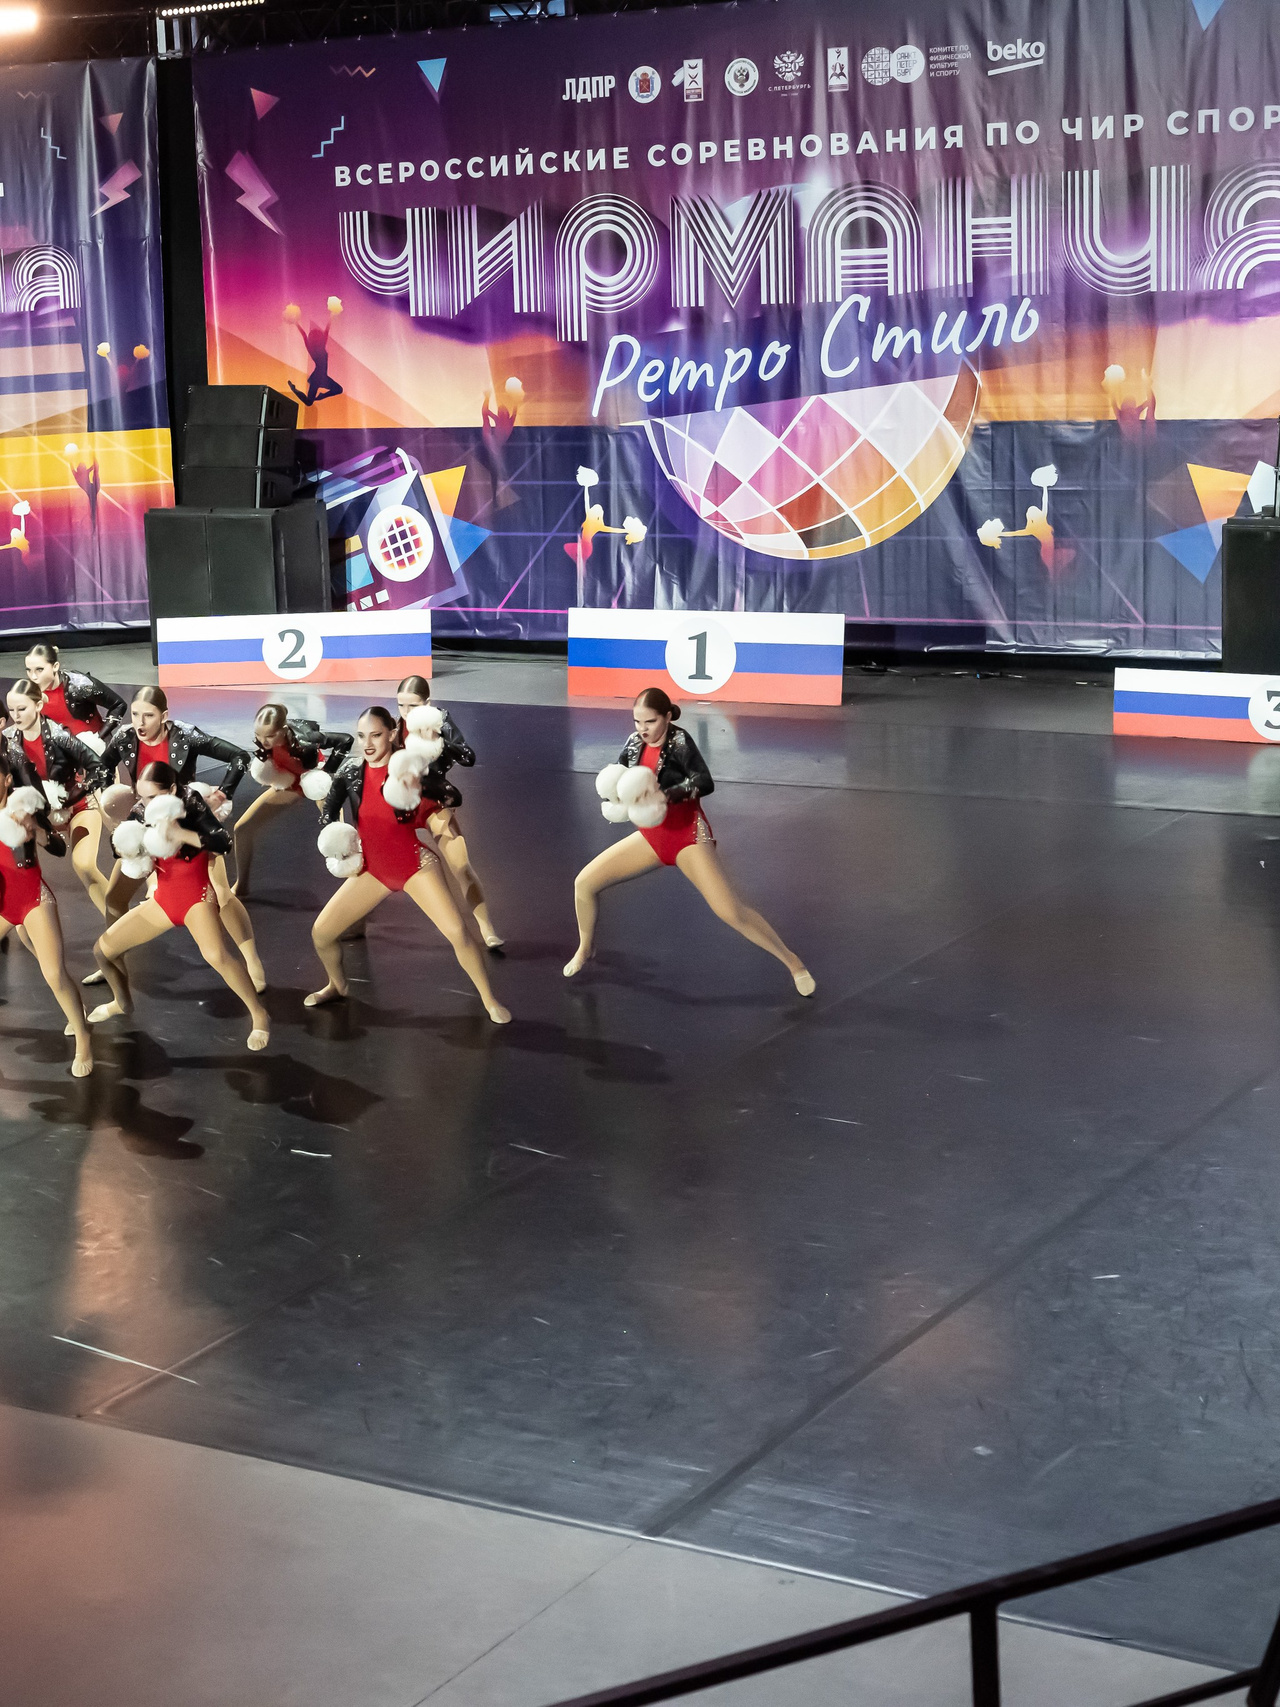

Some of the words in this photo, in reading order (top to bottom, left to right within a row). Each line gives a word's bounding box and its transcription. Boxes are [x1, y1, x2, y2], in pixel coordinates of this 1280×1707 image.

[929, 46, 957, 54] КОМИТЕТ
[929, 52, 971, 61] ФИЗИЧЕСКОЙ
[987, 38, 1045, 61] beko
[929, 61, 958, 69] КУЛЬТУРЕ
[936, 69, 960, 77] СПОРТУ
[562, 75, 616, 103] ЛДПР
[334, 147, 631, 187] ВСЕРОССИЙСКИЕ
[646, 124, 964, 168] СОРЕВНОВАНИЯ
[986, 120, 1040, 147] ПО
[1061, 113, 1144, 141] ЧИР
[592, 333, 791, 418] Ретро
[819, 293, 1040, 379] Стиль
[277, 628, 307, 669] 2
[687, 631, 713, 680] 1
